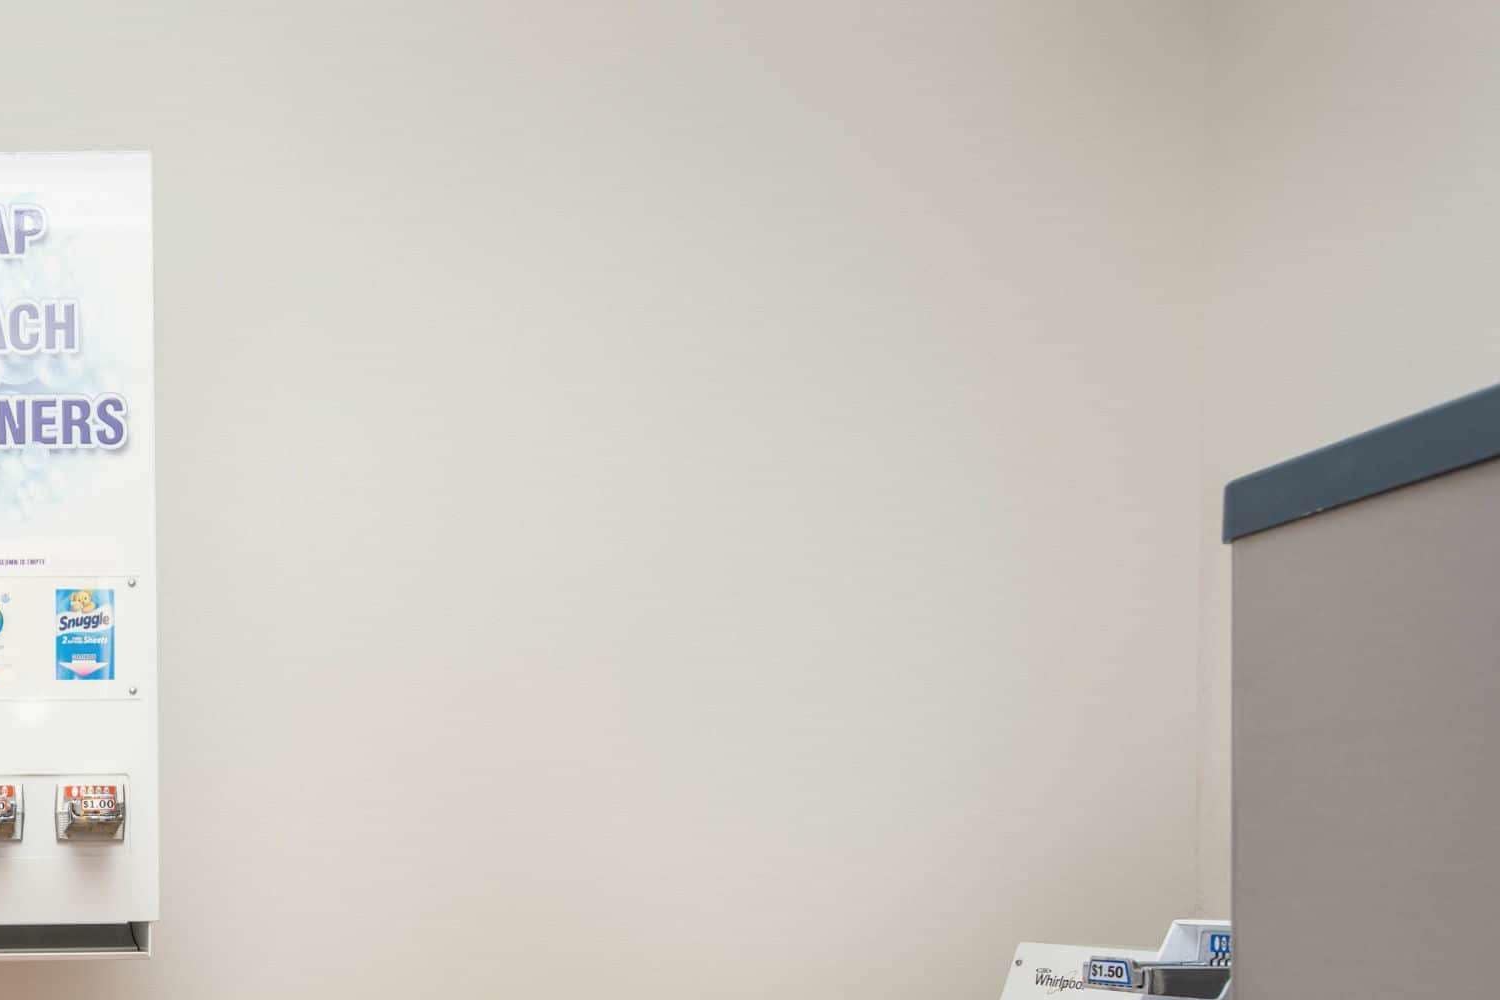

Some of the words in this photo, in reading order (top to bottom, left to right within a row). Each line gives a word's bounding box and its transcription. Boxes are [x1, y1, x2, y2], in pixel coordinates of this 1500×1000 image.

[58, 611, 110, 632] Snuggle
[82, 799, 115, 809] $1.00
[1091, 963, 1124, 979] $1.50
[1035, 973, 1085, 992] Whirlpoo
